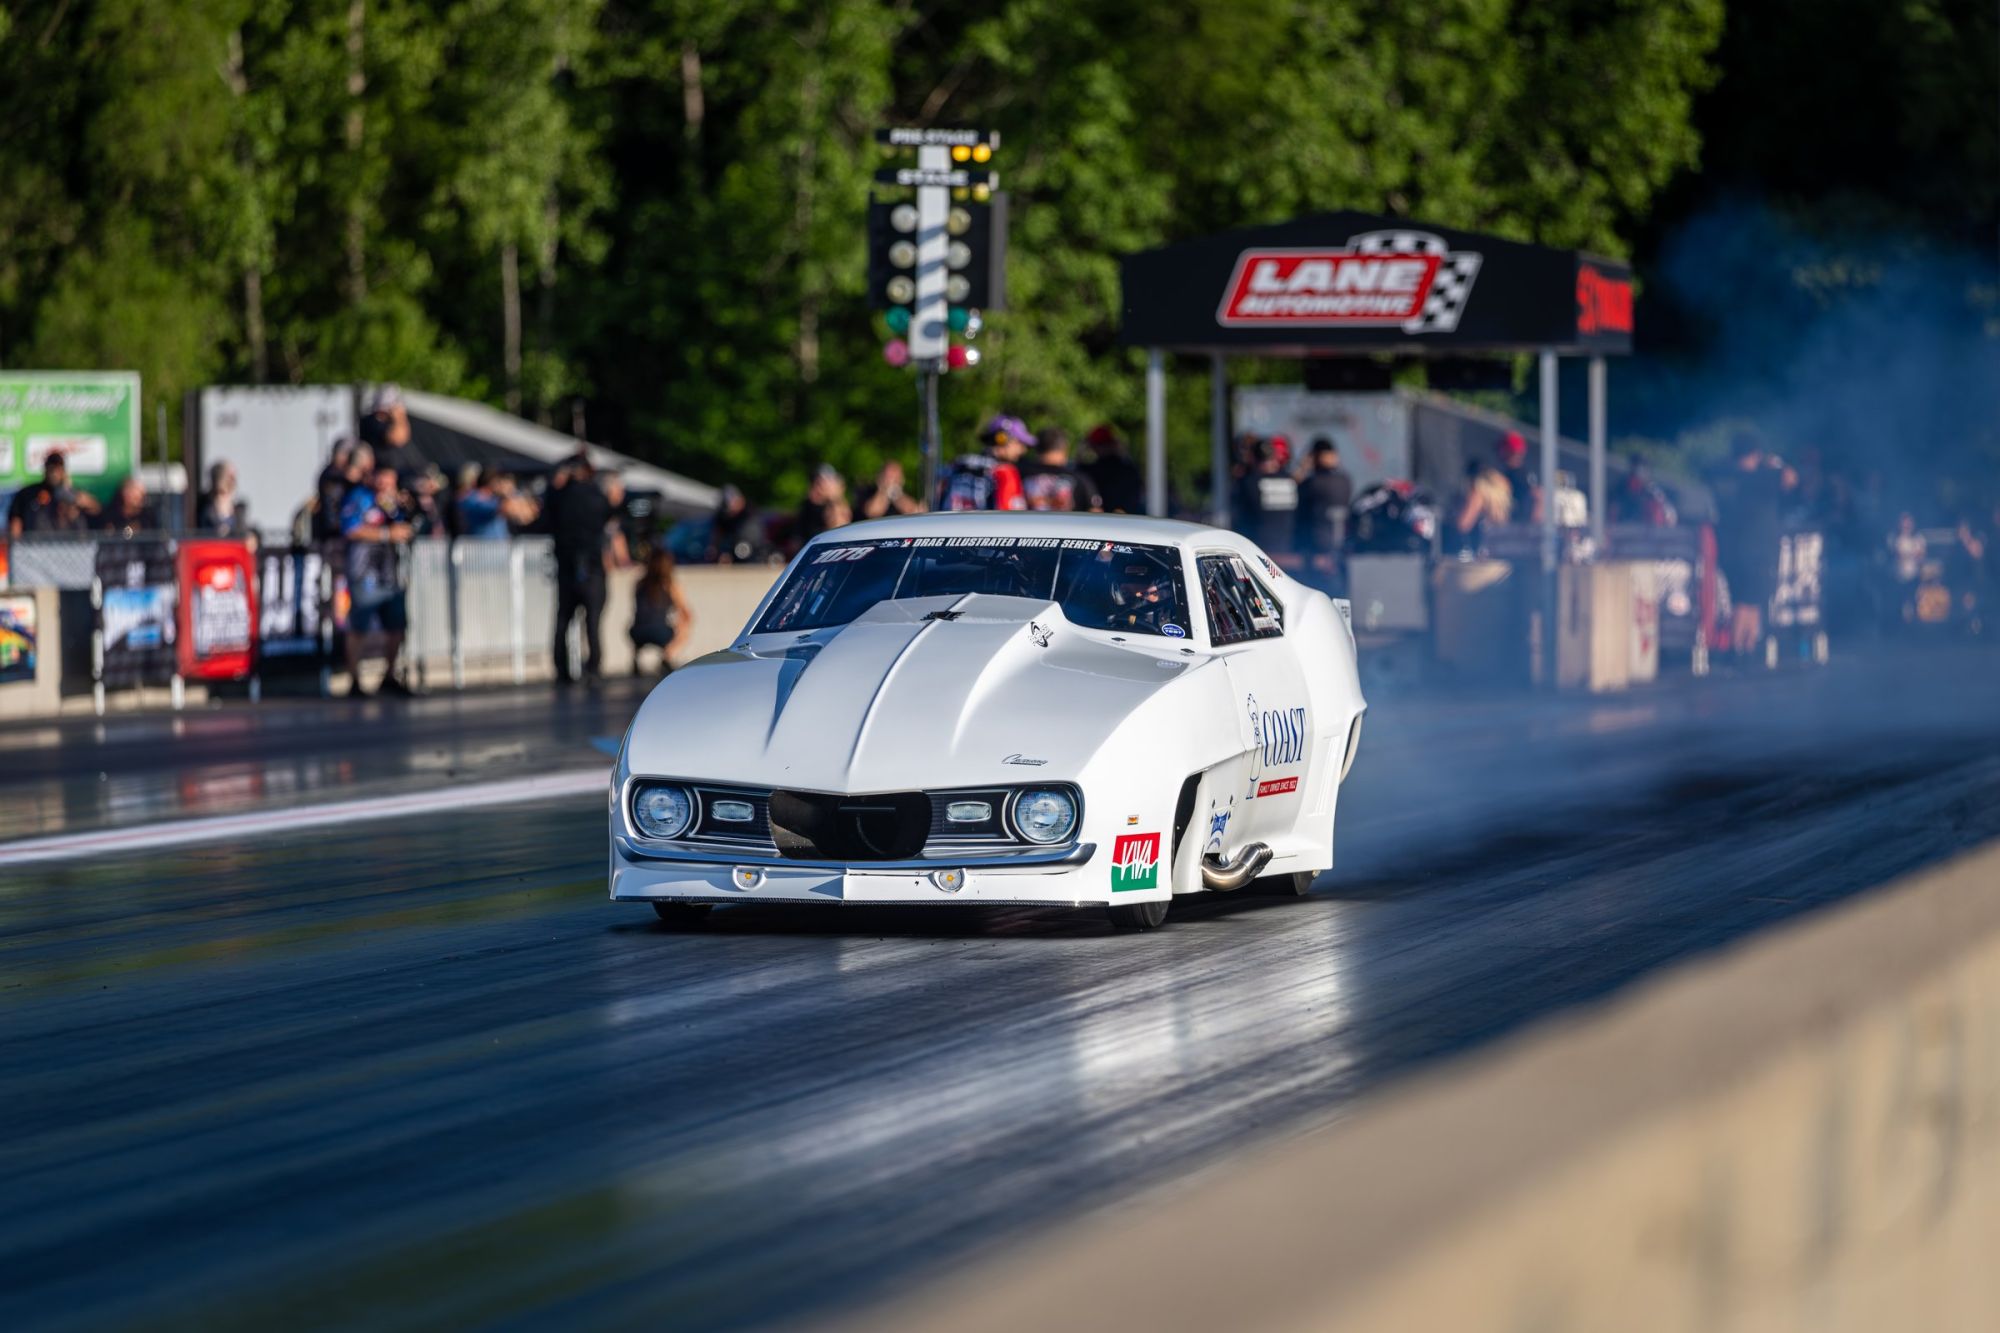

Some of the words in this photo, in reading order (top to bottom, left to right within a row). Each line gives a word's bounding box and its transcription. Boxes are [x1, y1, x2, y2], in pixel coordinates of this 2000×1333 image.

[897, 169, 968, 185] STAGE
[1249, 259, 1428, 292] LANE
[1236, 294, 1417, 316] AUTOMOTIVE
[912, 537, 944, 547] DRAG
[945, 536, 1016, 547] ILLUSTRATED
[1016, 537, 1060, 548] WINTER
[1060, 539, 1100, 550] SERIES
[1263, 708, 1306, 767] COAST
[1120, 839, 1153, 881] VIVA
